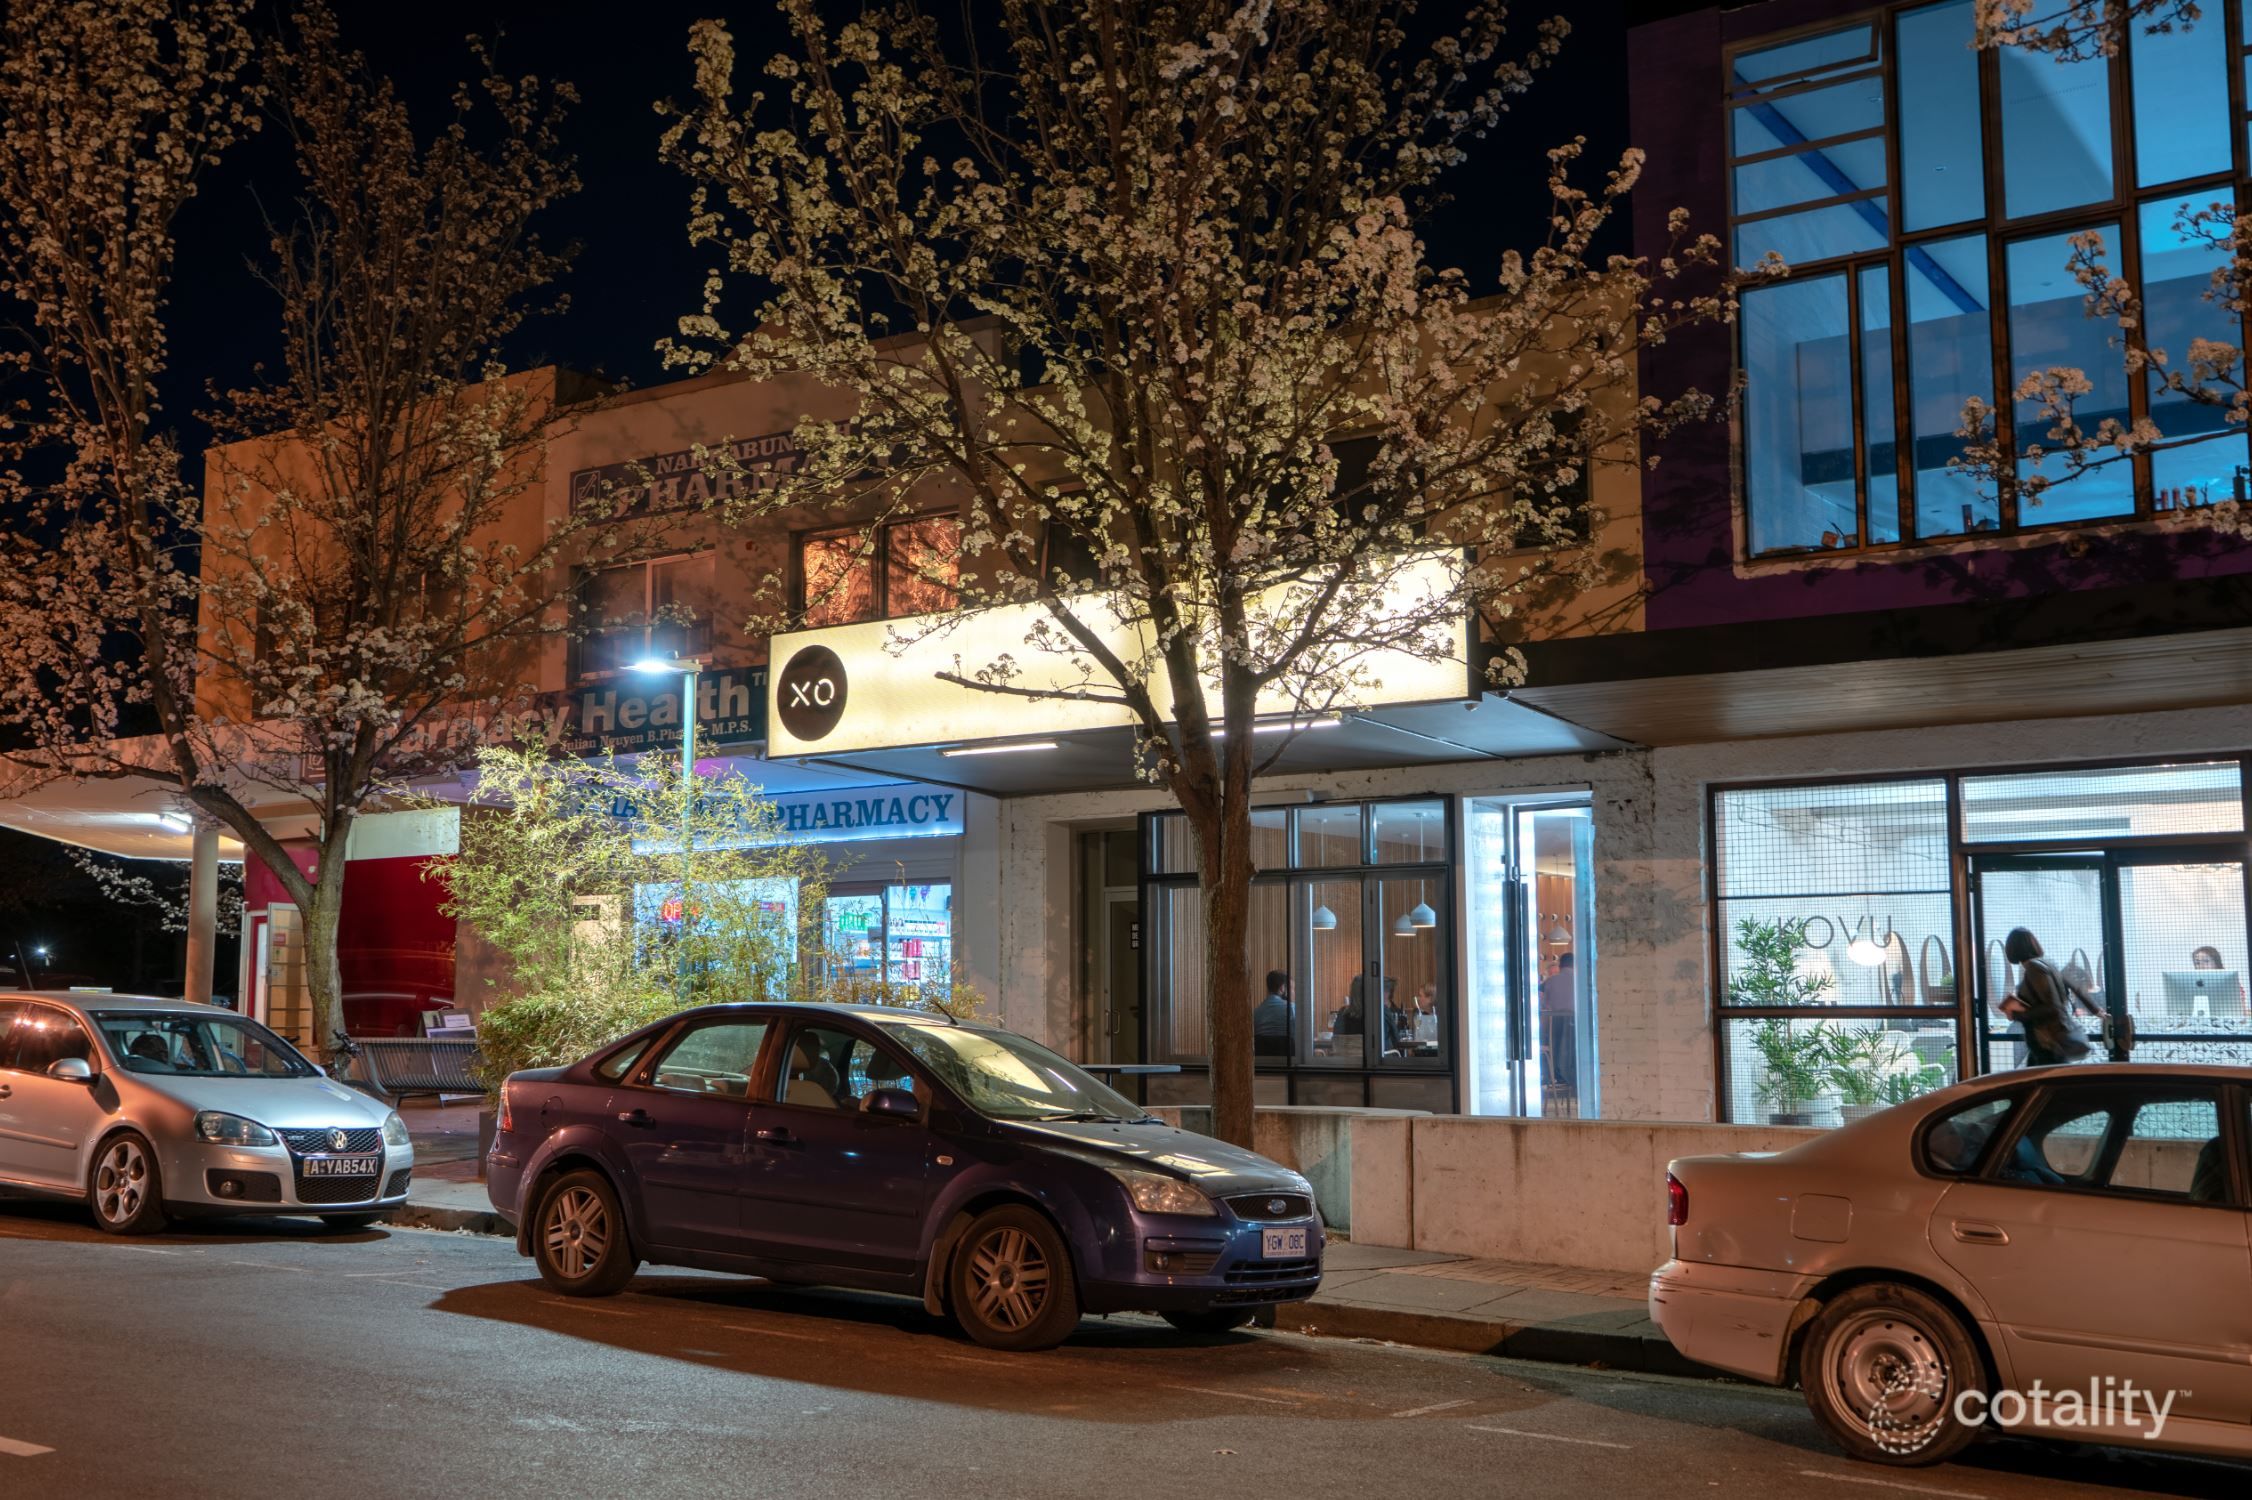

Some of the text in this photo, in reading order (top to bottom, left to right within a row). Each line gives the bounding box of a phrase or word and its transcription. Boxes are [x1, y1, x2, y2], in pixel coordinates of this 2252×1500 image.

[656, 422, 851, 475] NARABUNH
[613, 439, 903, 518] PHARMY
[582, 675, 750, 734] Heath
[790, 678, 835, 708] XO
[600, 734, 644, 750] Nguyen
[712, 719, 753, 736] M.P.S.
[767, 793, 954, 831] PHARMACY
[1778, 915, 1892, 949] KOVU
